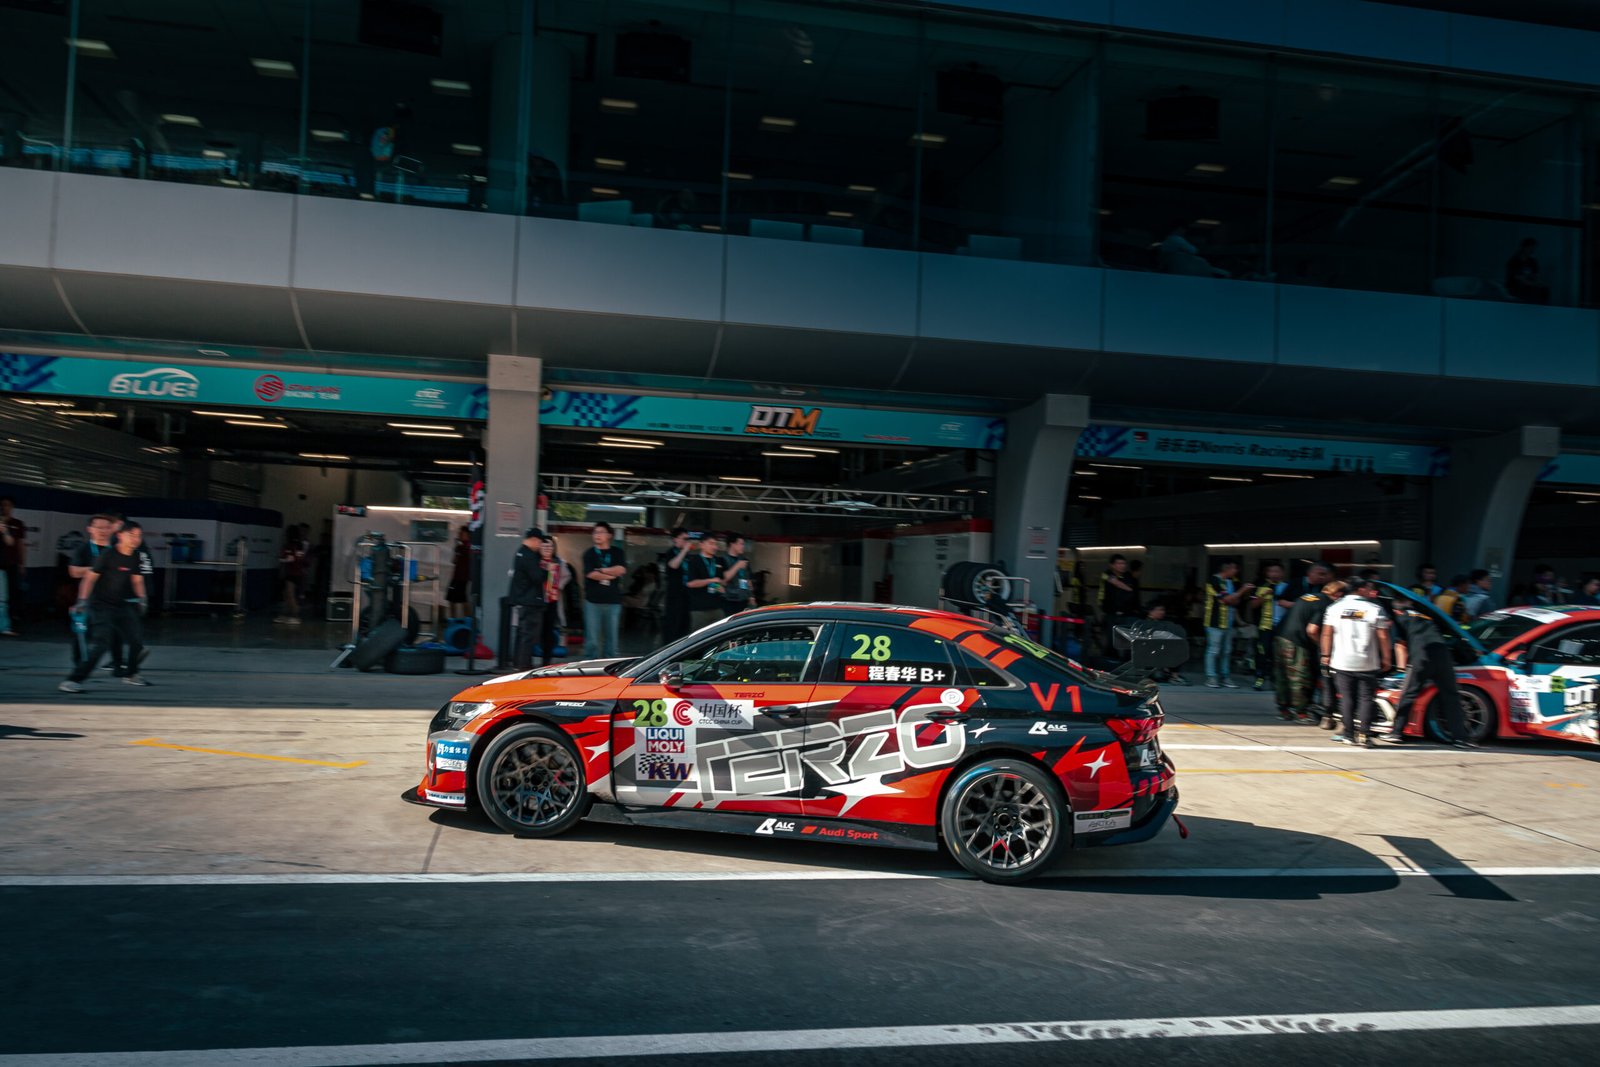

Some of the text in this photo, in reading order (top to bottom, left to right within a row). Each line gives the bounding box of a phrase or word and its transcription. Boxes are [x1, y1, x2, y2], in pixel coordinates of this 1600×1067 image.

[746, 405, 821, 435] DTM
[850, 634, 891, 661] 28
[869, 666, 946, 682] 程春华 B+
[1029, 682, 1083, 713] V1
[632, 699, 668, 727] 28
[698, 703, 742, 719] 中国杯
[647, 729, 683, 740] LIQUI
[647, 741, 684, 752] MOLY
[694, 702, 965, 801] TERZO
[648, 762, 693, 780] KW
[775, 821, 795, 830] ALC
[818, 827, 879, 840] Audi Sport
